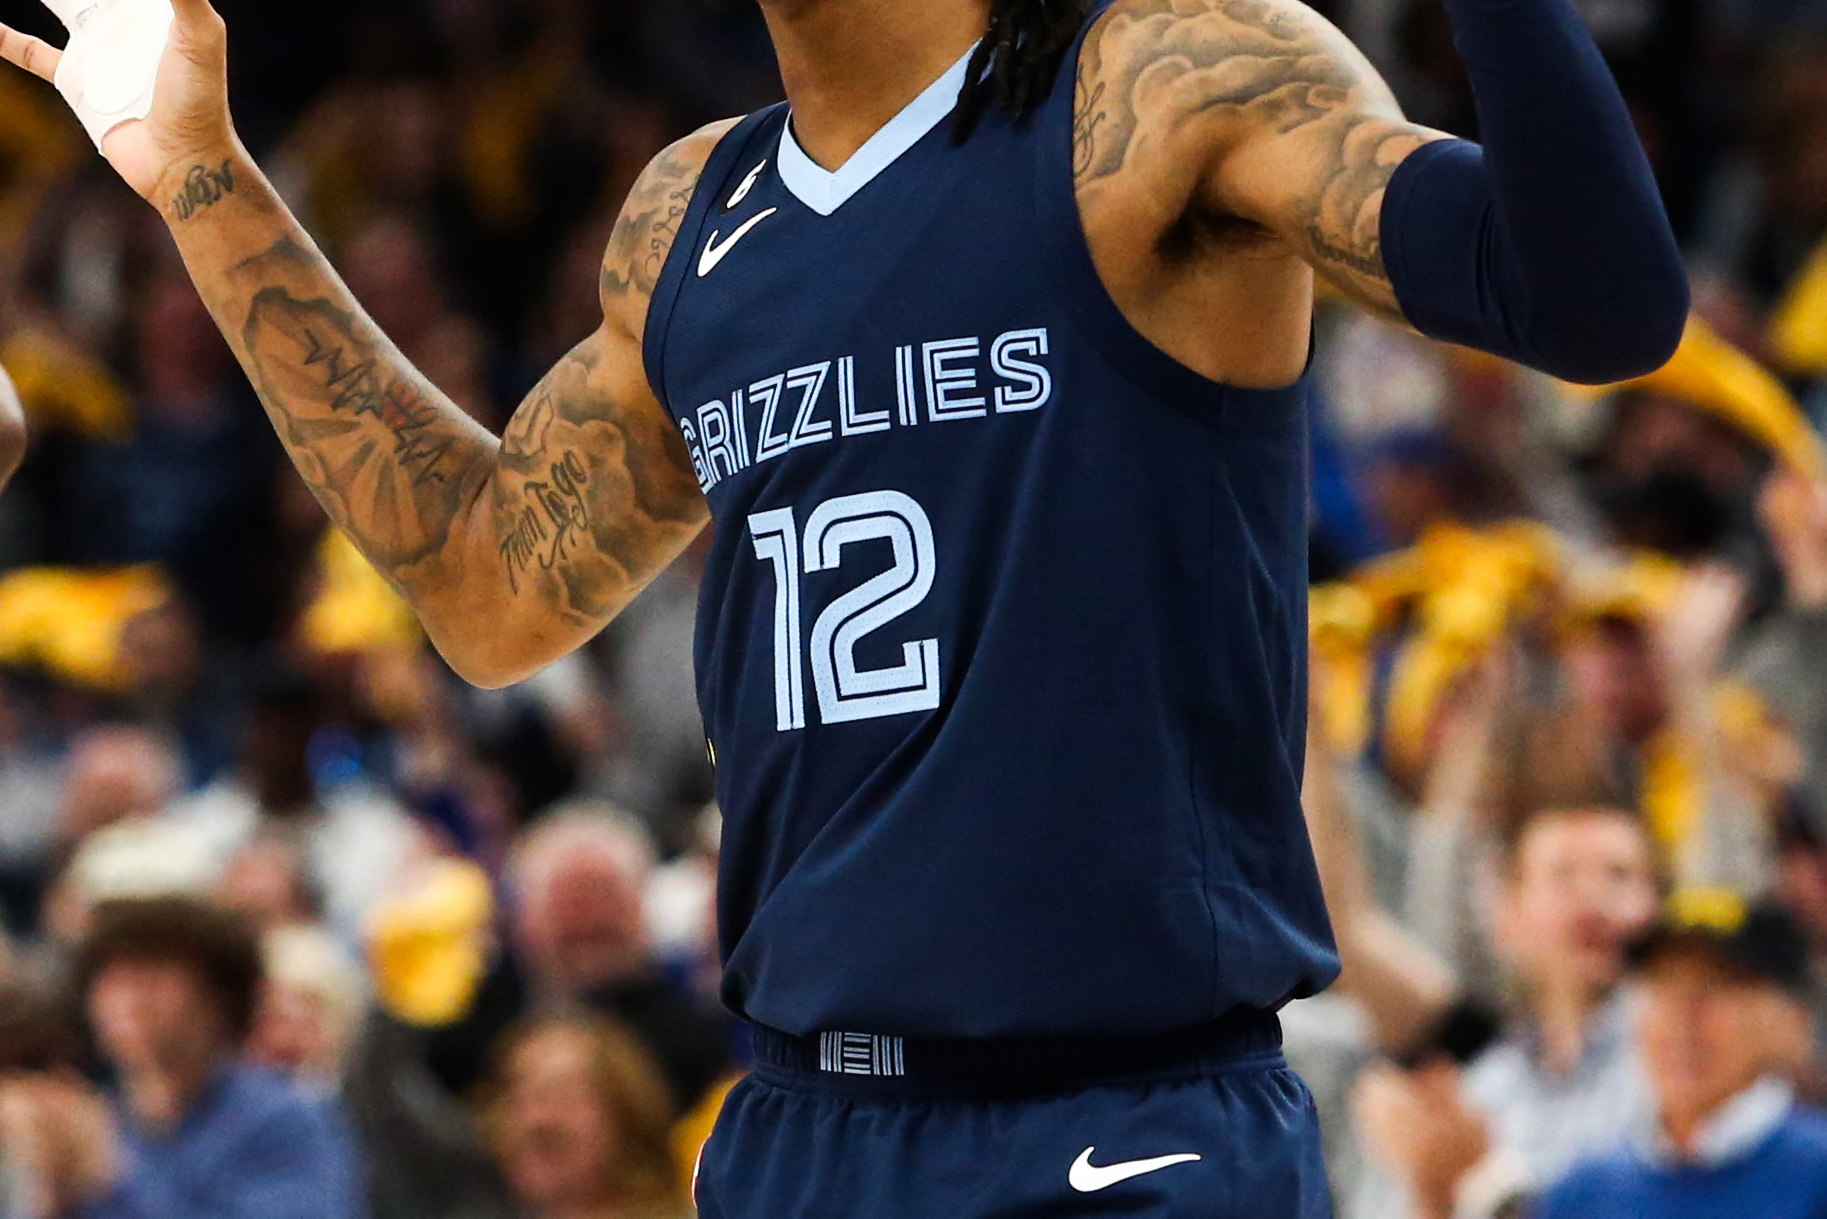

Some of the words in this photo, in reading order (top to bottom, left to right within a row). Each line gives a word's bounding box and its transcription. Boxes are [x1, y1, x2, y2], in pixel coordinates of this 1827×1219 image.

[726, 158, 767, 210] 6
[680, 327, 1052, 495] GRIZZLIES
[747, 489, 940, 732] 12
